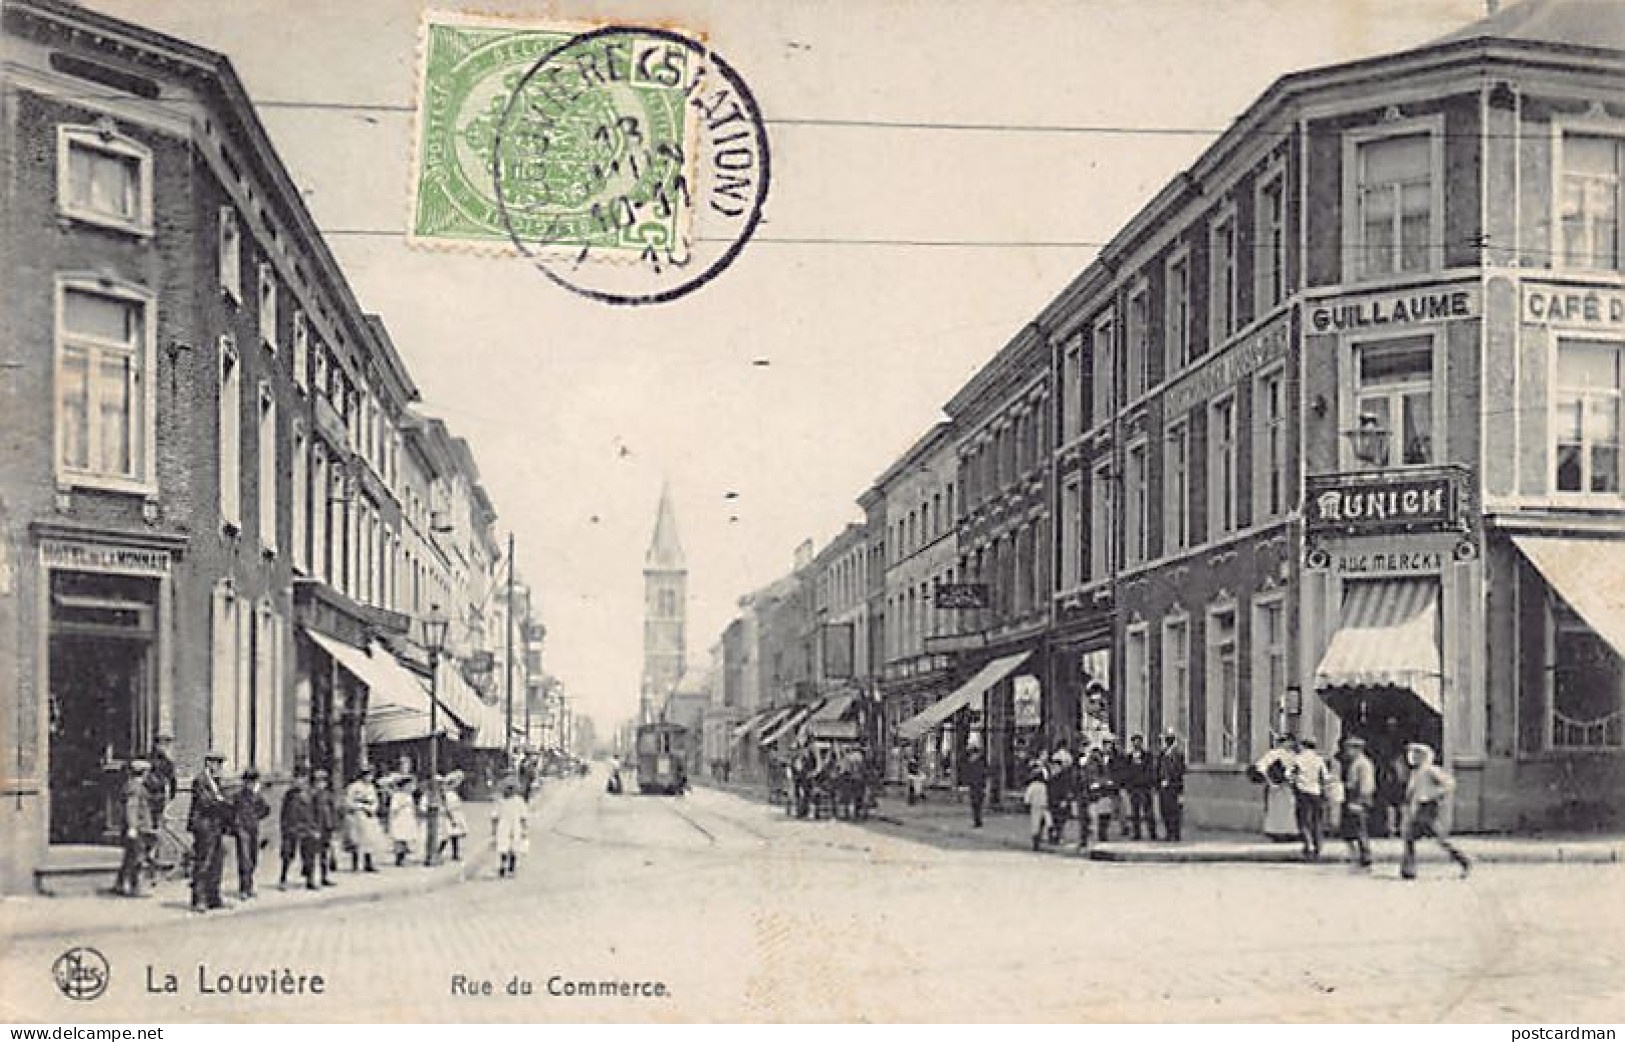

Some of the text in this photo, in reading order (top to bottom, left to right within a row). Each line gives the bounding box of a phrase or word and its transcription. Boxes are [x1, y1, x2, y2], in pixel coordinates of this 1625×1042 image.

[1313, 292, 1469, 331] GUILLAUME
[1529, 291, 1600, 321] CAFÉ
[1318, 489, 1443, 520] MUNICH
